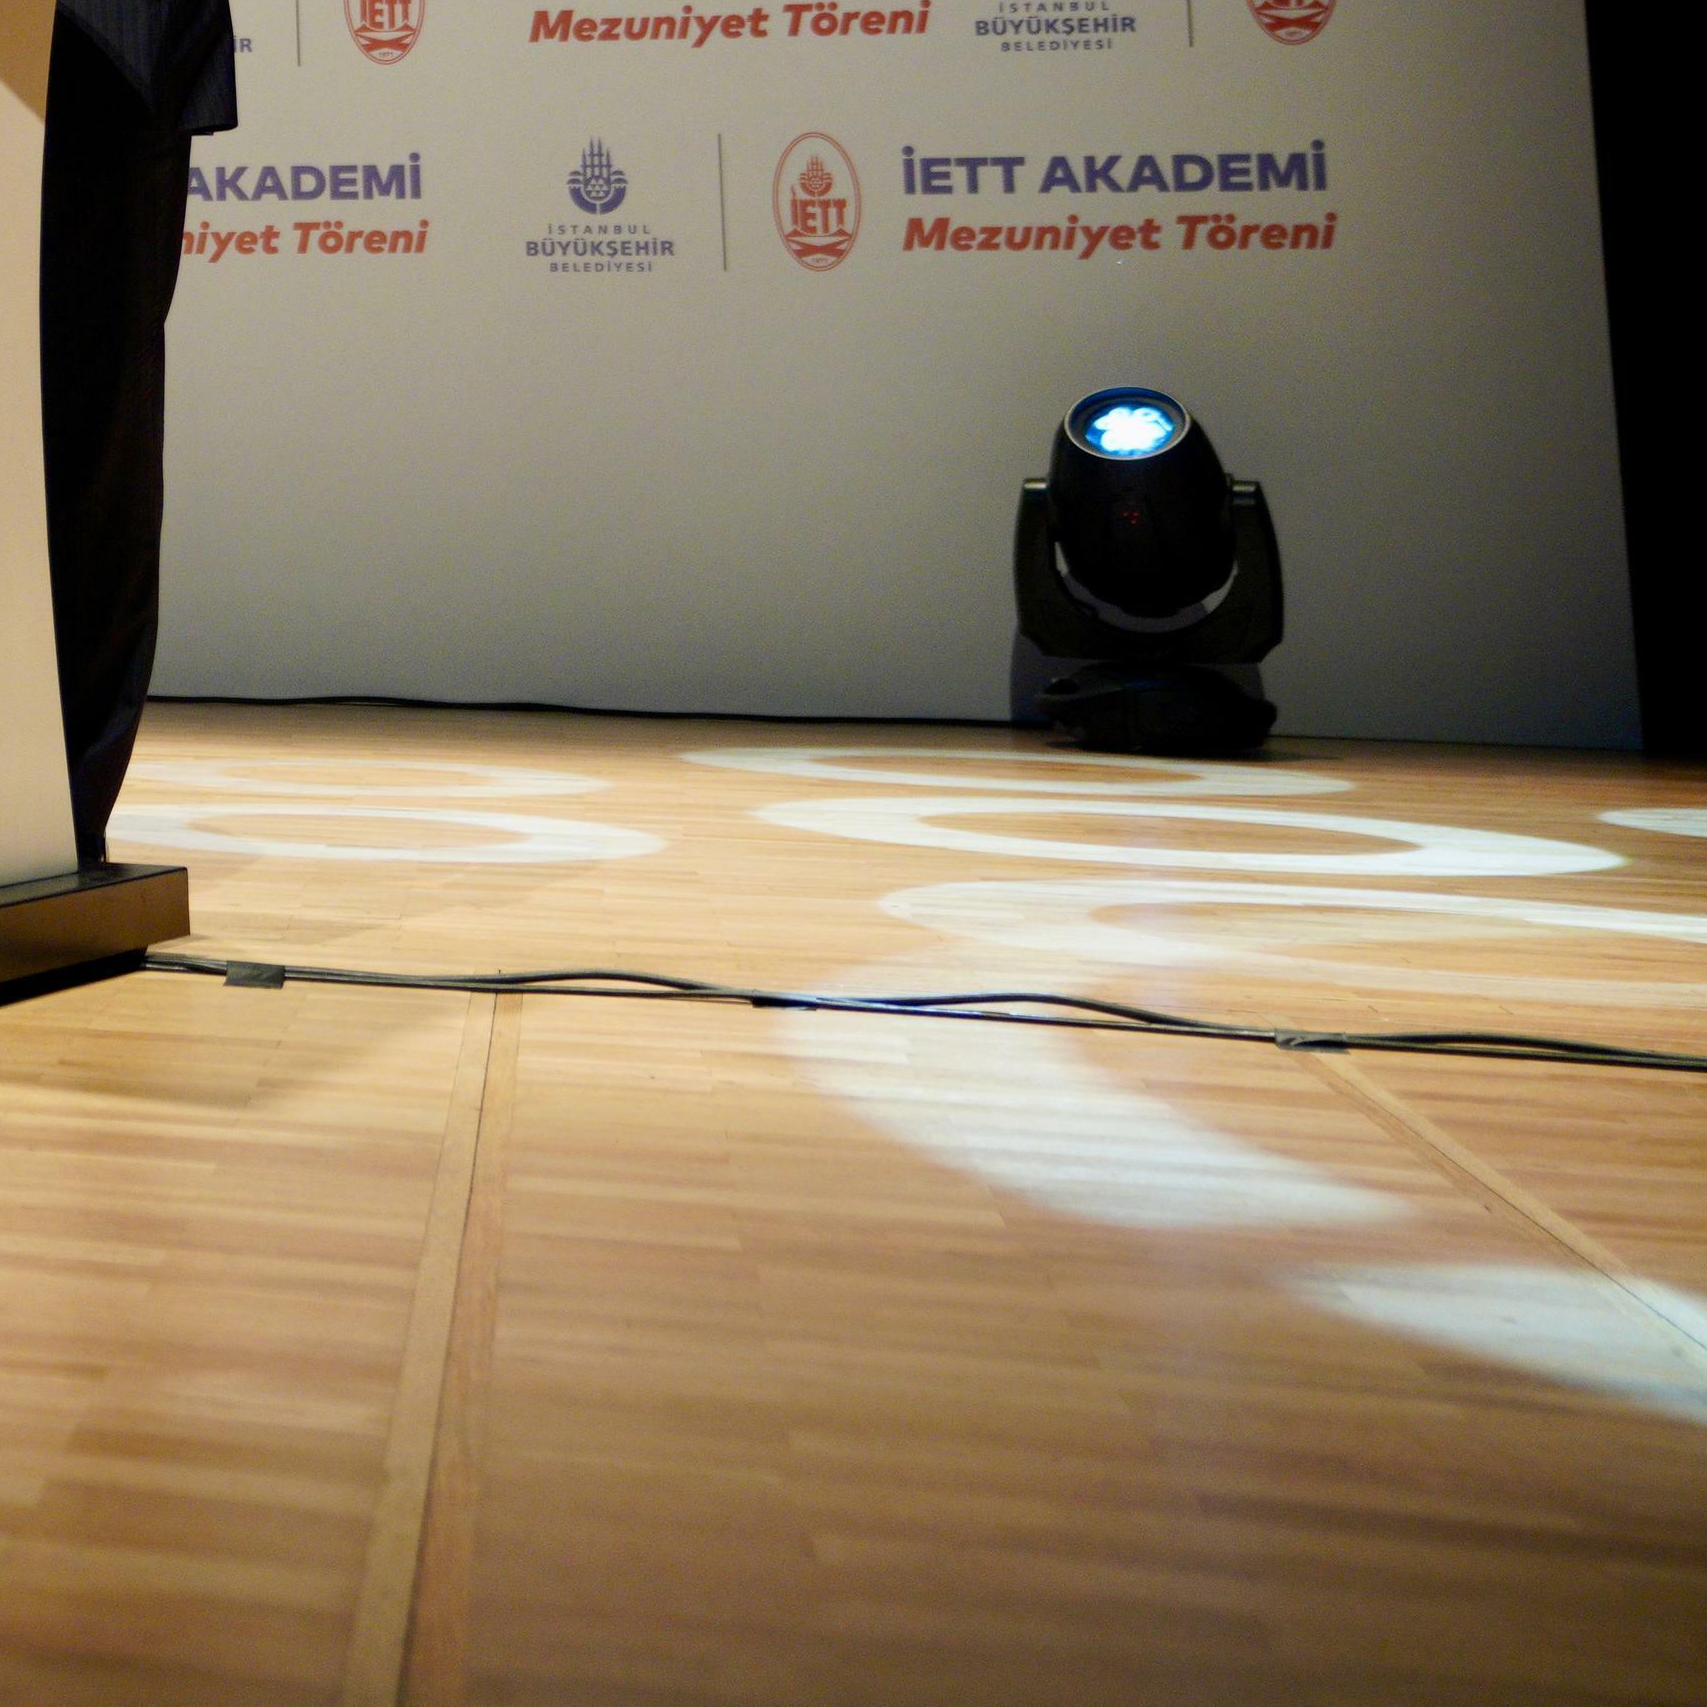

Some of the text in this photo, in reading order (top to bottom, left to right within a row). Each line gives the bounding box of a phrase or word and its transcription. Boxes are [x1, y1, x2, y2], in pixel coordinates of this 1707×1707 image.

[1000, 1, 1109, 13] İSTANBUL
[530, 0, 931, 48] Mezuniyet Töreni
[975, 13, 1137, 36] BÜYÜKŞEHİR
[1001, 37, 1112, 52] BELEDİYESİ
[187, 152, 423, 202] AKADEMİ
[903, 140, 1327, 194] İETT AKADEMİ
[292, 219, 430, 255] Töreni
[547, 223, 651, 235] İSTANBUL
[904, 213, 1337, 259] Mezuniyet Töreni
[525, 237, 675, 259] BÜYÜKŞEHİR
[549, 260, 652, 273] BELEDİYESİ
